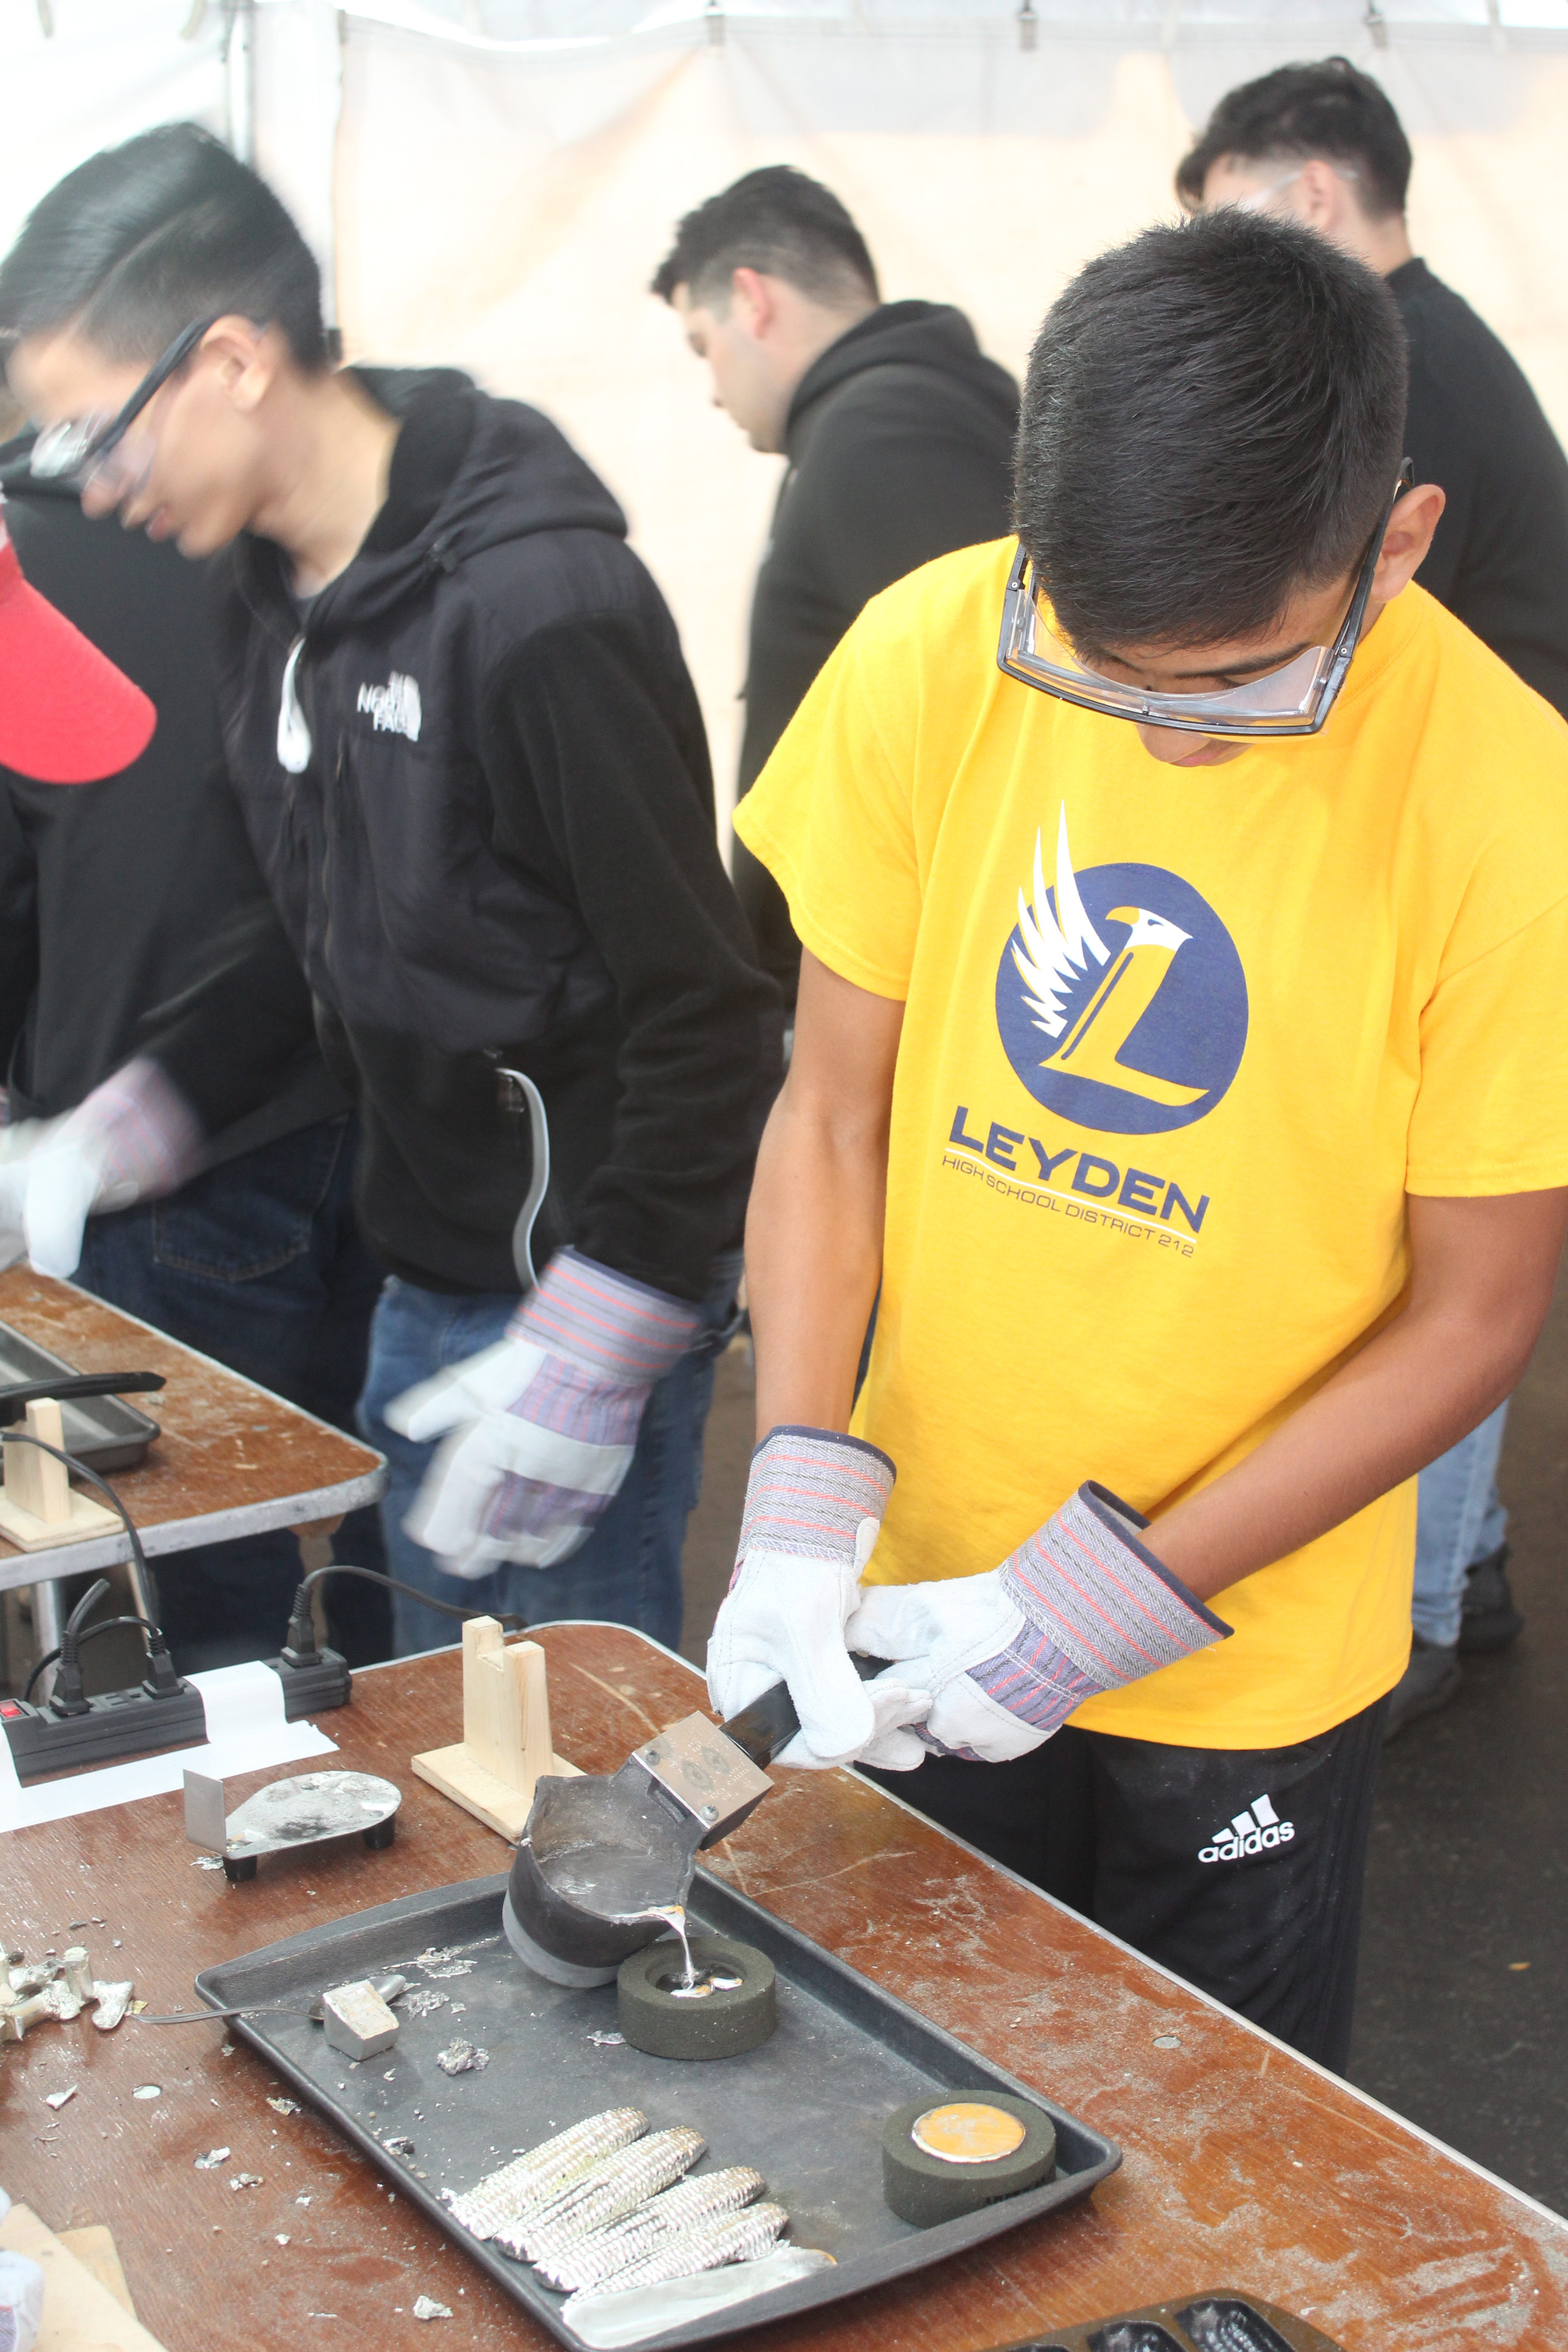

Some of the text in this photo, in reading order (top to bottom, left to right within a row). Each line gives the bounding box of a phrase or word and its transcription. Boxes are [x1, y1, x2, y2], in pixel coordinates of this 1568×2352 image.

[942, 1156, 1195, 1258] HIGH SCHOOL DISTRICT 212
[949, 1105, 1211, 1234] LEYDEN
[1198, 1821, 1295, 1863] adidas
